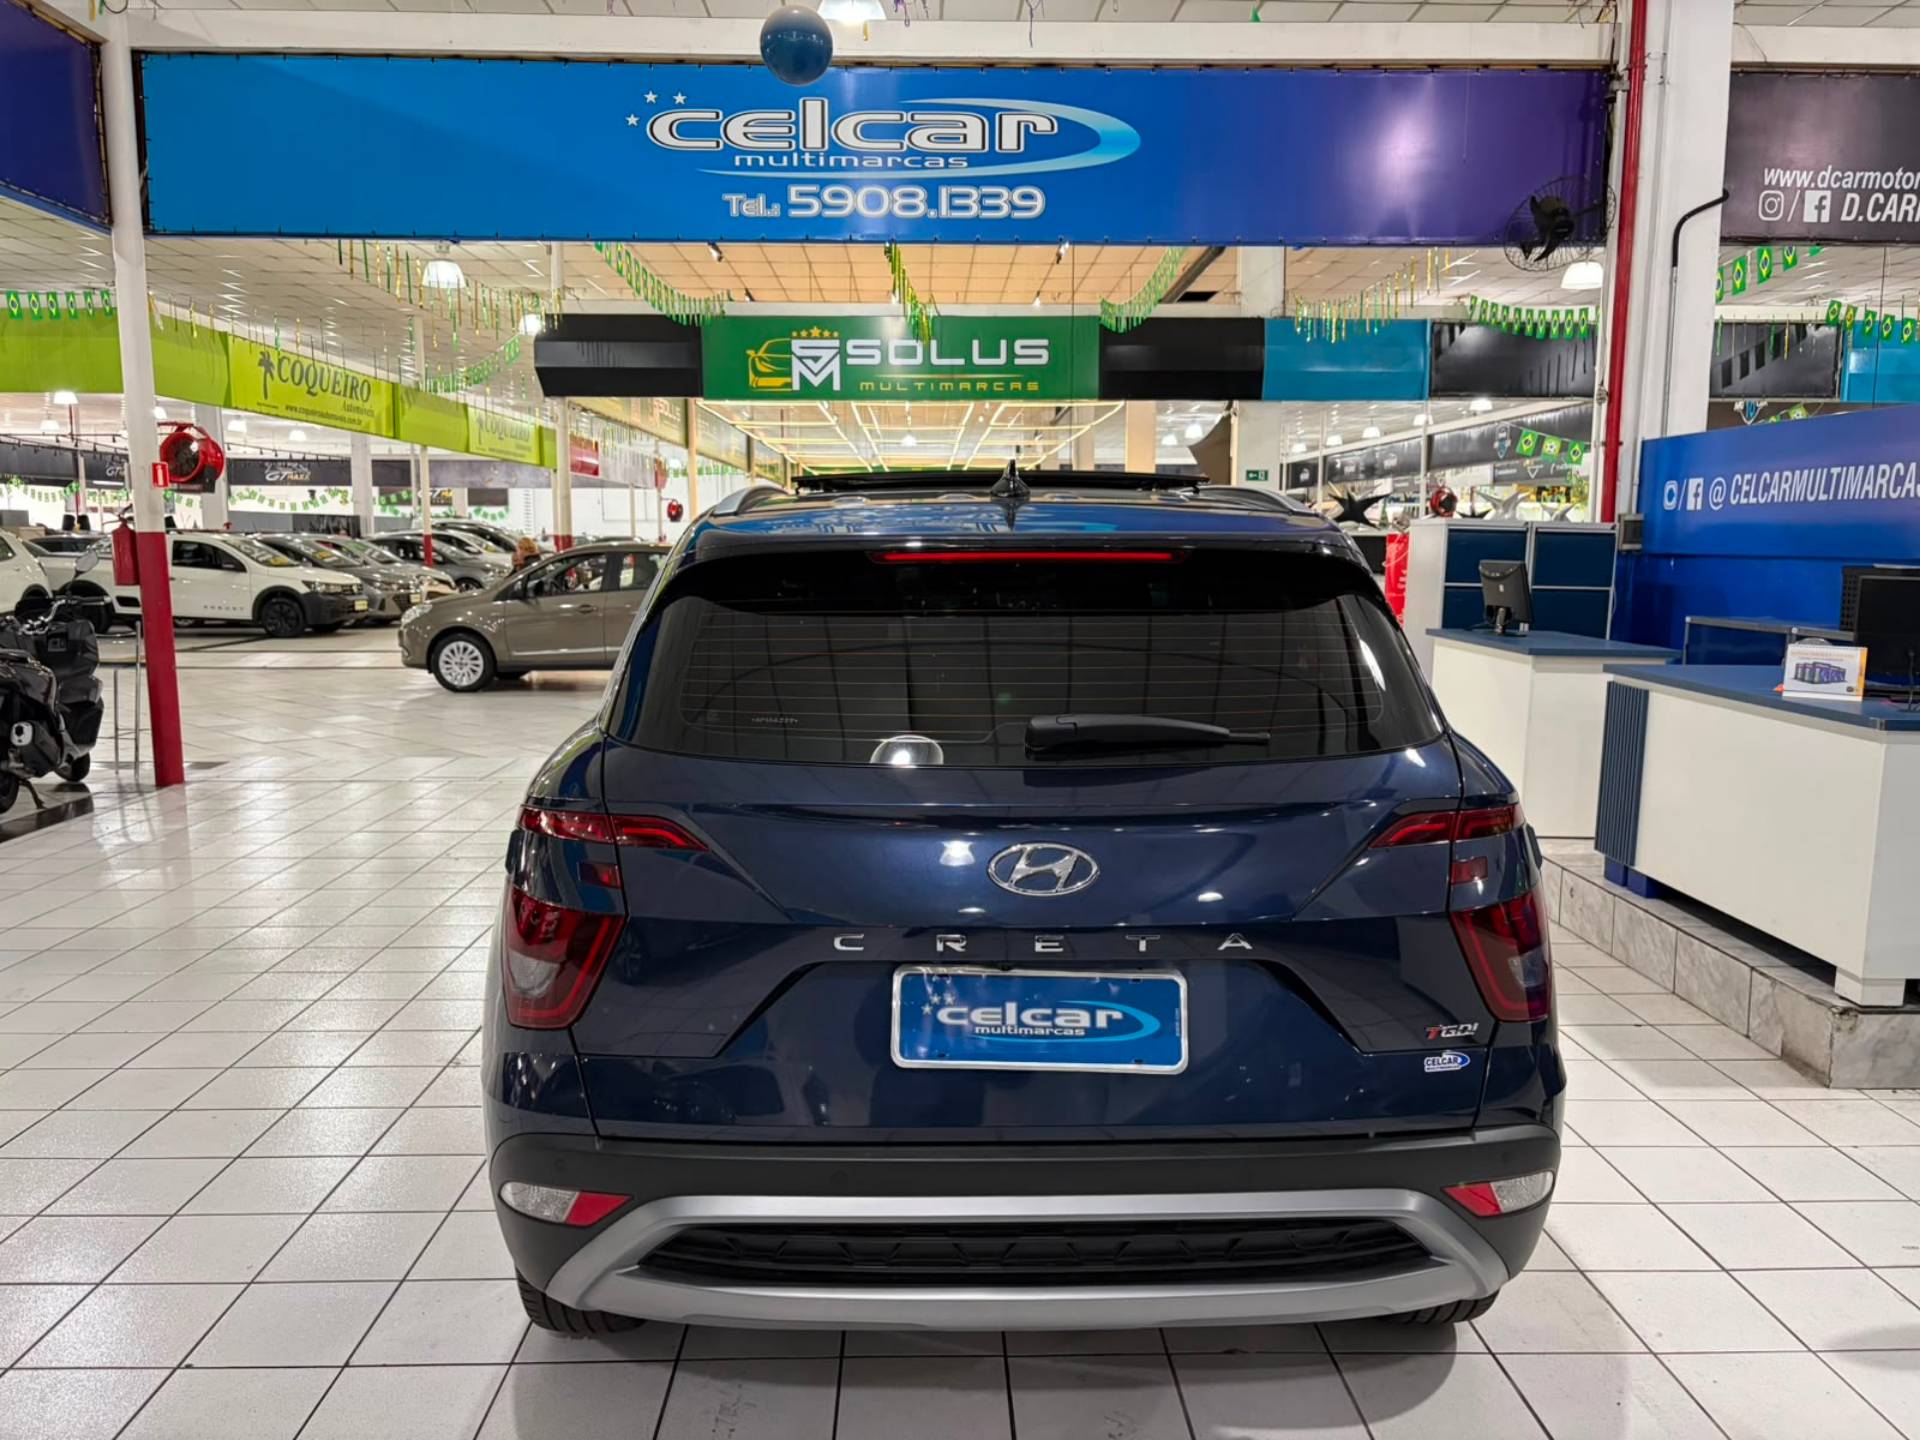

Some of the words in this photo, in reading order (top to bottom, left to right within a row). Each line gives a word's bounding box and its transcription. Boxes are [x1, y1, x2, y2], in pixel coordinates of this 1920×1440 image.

[645, 97, 1060, 155] celcar
[734, 152, 969, 169] multimarcas
[787, 184, 1046, 219] 5908.1339
[846, 338, 1050, 365] SOLUS
[277, 355, 372, 403] COQUEIRO
[859, 381, 1041, 391] MULTIMARCAS
[833, 933, 1253, 952] CRETA
[937, 1002, 1123, 1027] celcar
[974, 1023, 1086, 1037] multimarcas
[1426, 1056, 1459, 1066] CELCAR
